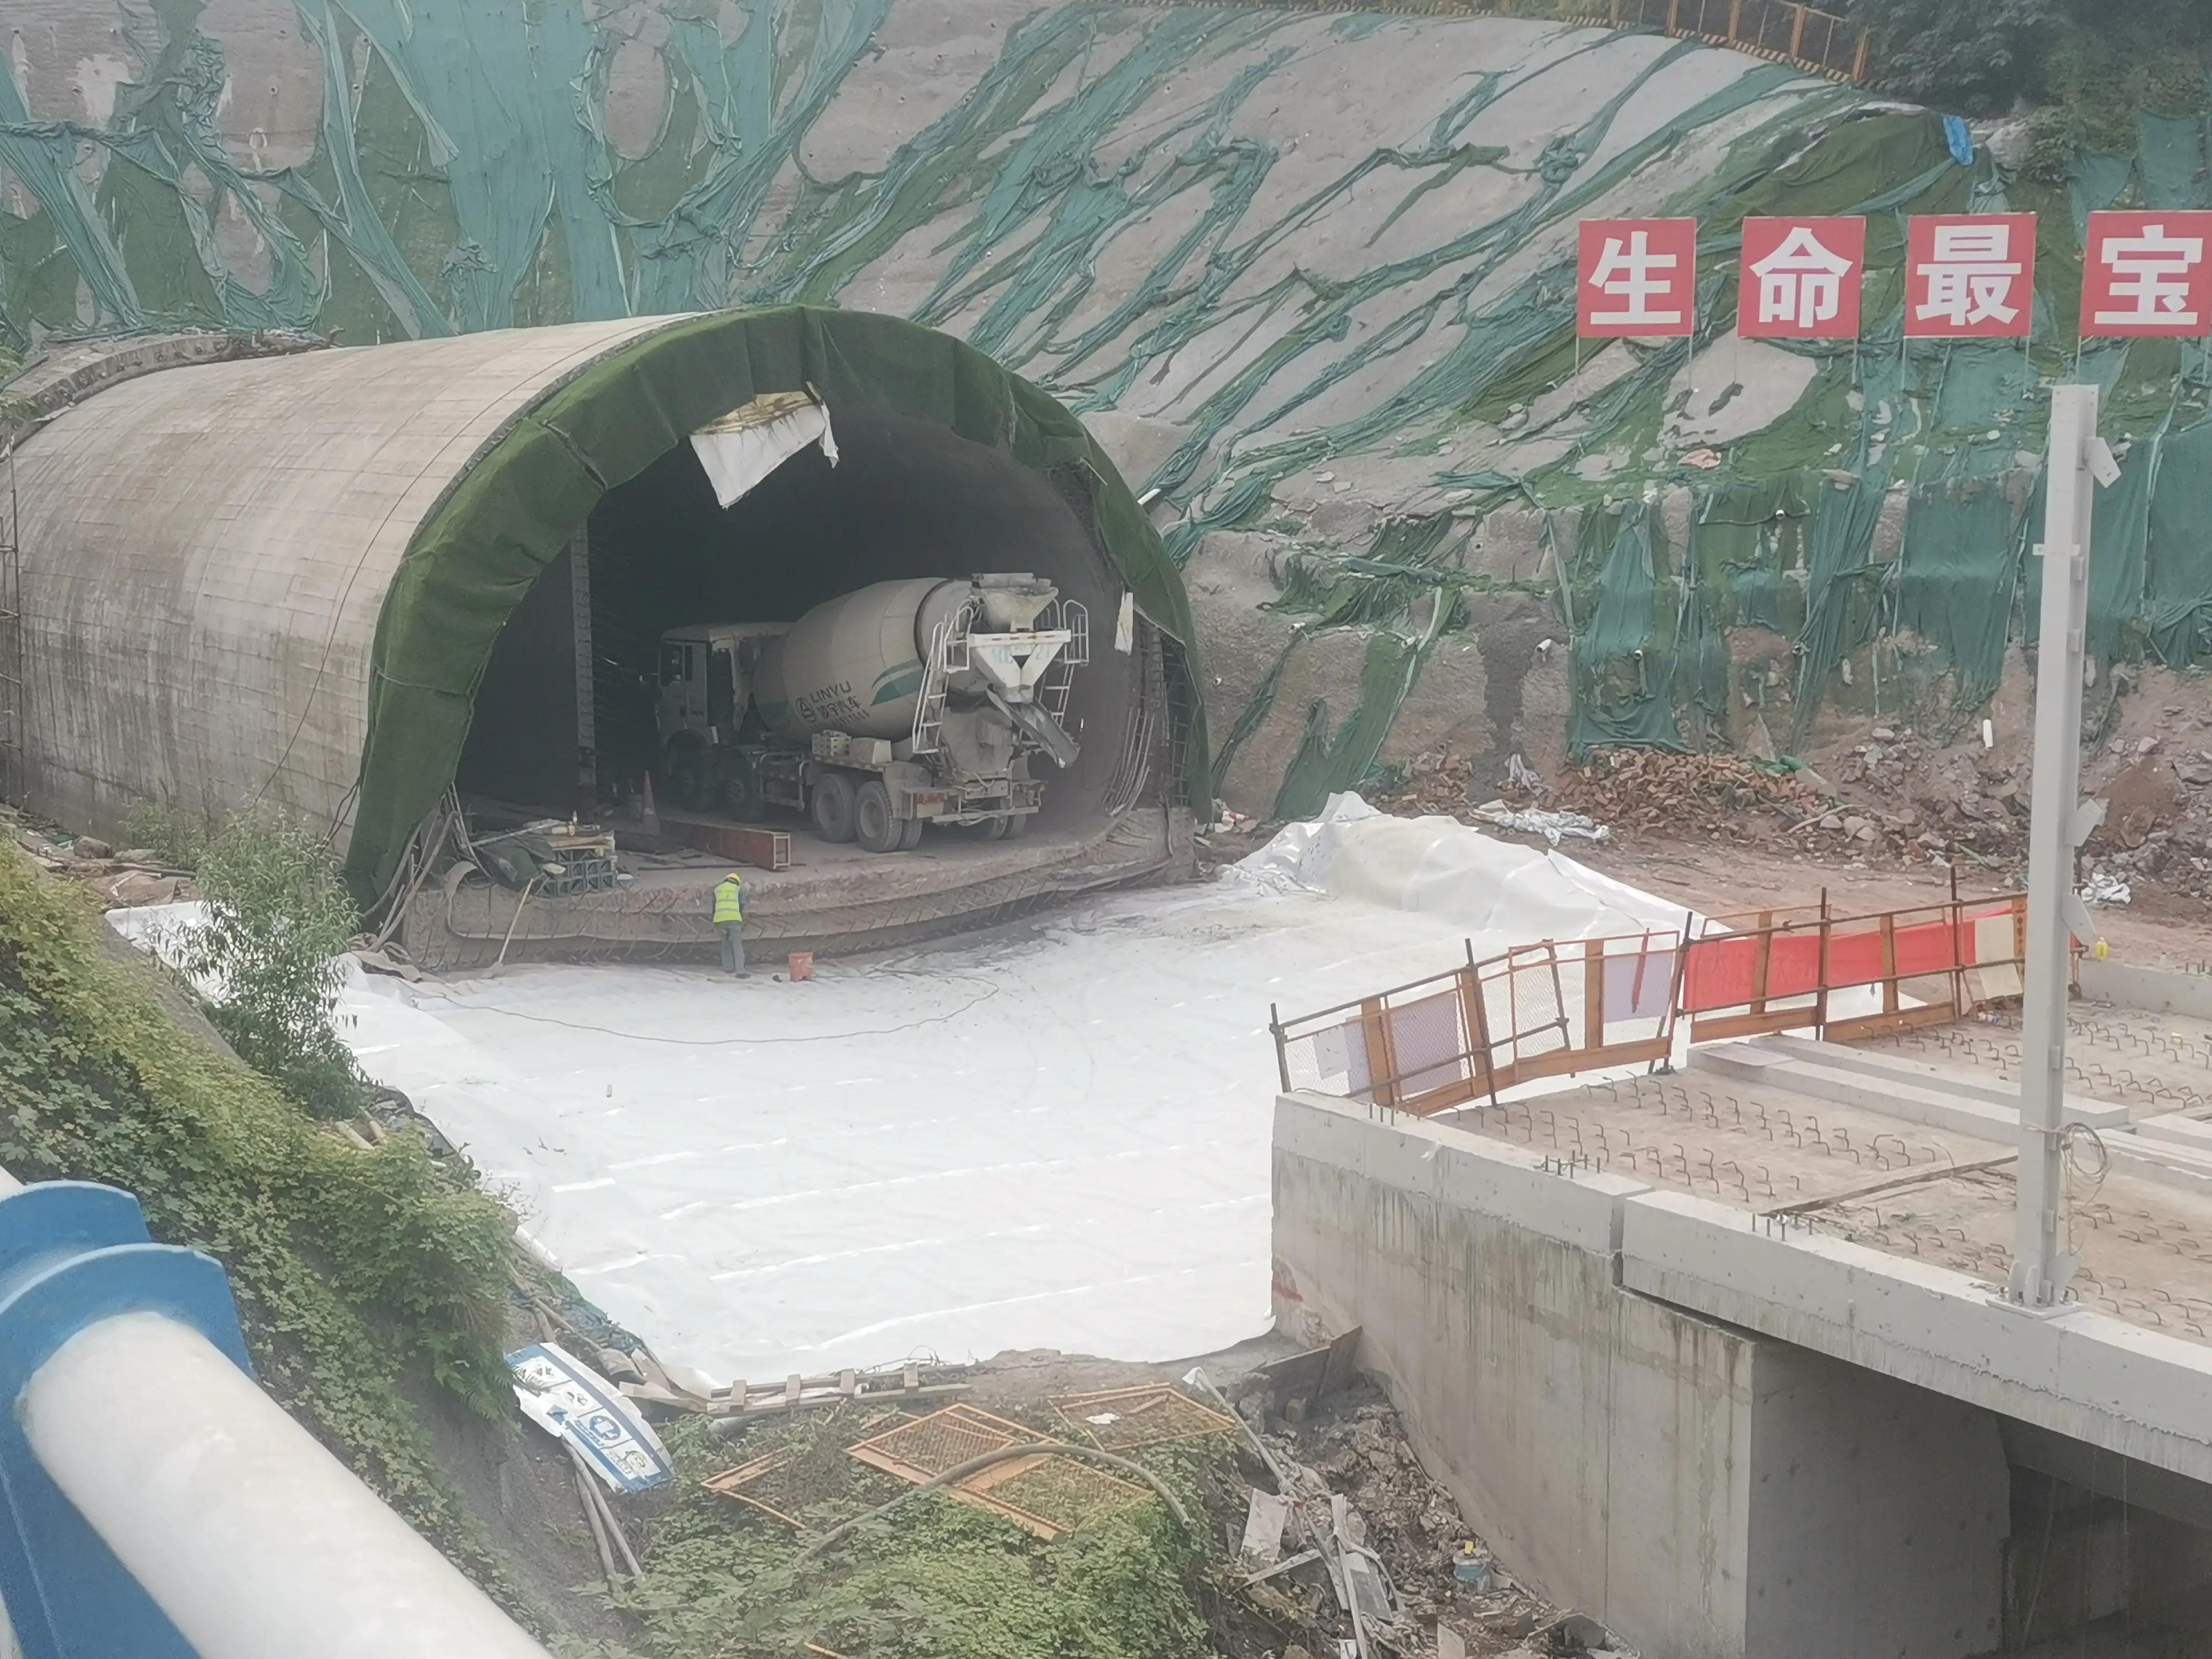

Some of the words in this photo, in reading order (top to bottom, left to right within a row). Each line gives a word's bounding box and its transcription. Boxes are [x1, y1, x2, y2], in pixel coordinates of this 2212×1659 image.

[1589, 224, 2203, 328] 生命最宝
[810, 681, 852, 703] LINYU
